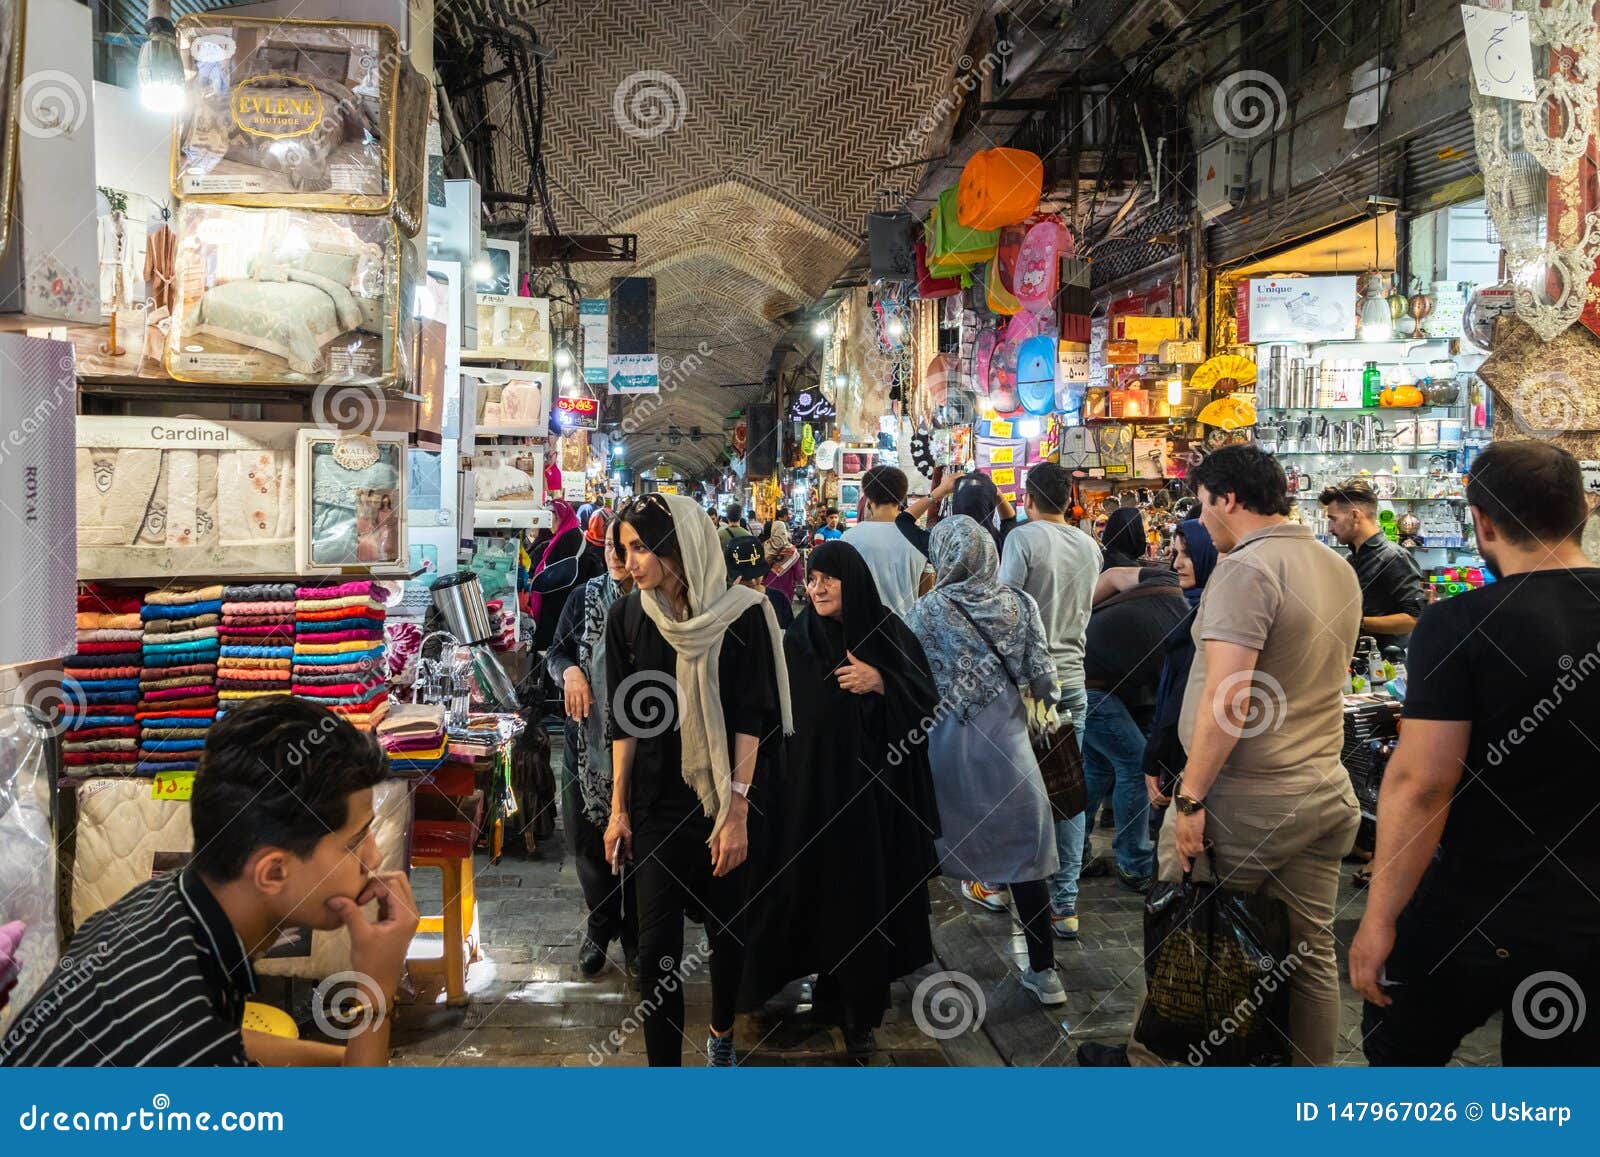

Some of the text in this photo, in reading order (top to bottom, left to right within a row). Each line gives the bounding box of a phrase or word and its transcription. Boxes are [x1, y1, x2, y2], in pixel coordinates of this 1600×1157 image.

[238, 96, 315, 116] EVLENE
[253, 117, 300, 125] BOUTIQUE
[1257, 282, 1293, 294] Unique
[151, 425, 229, 441] Cardinal
[25, 466, 38, 526] ROYAL
